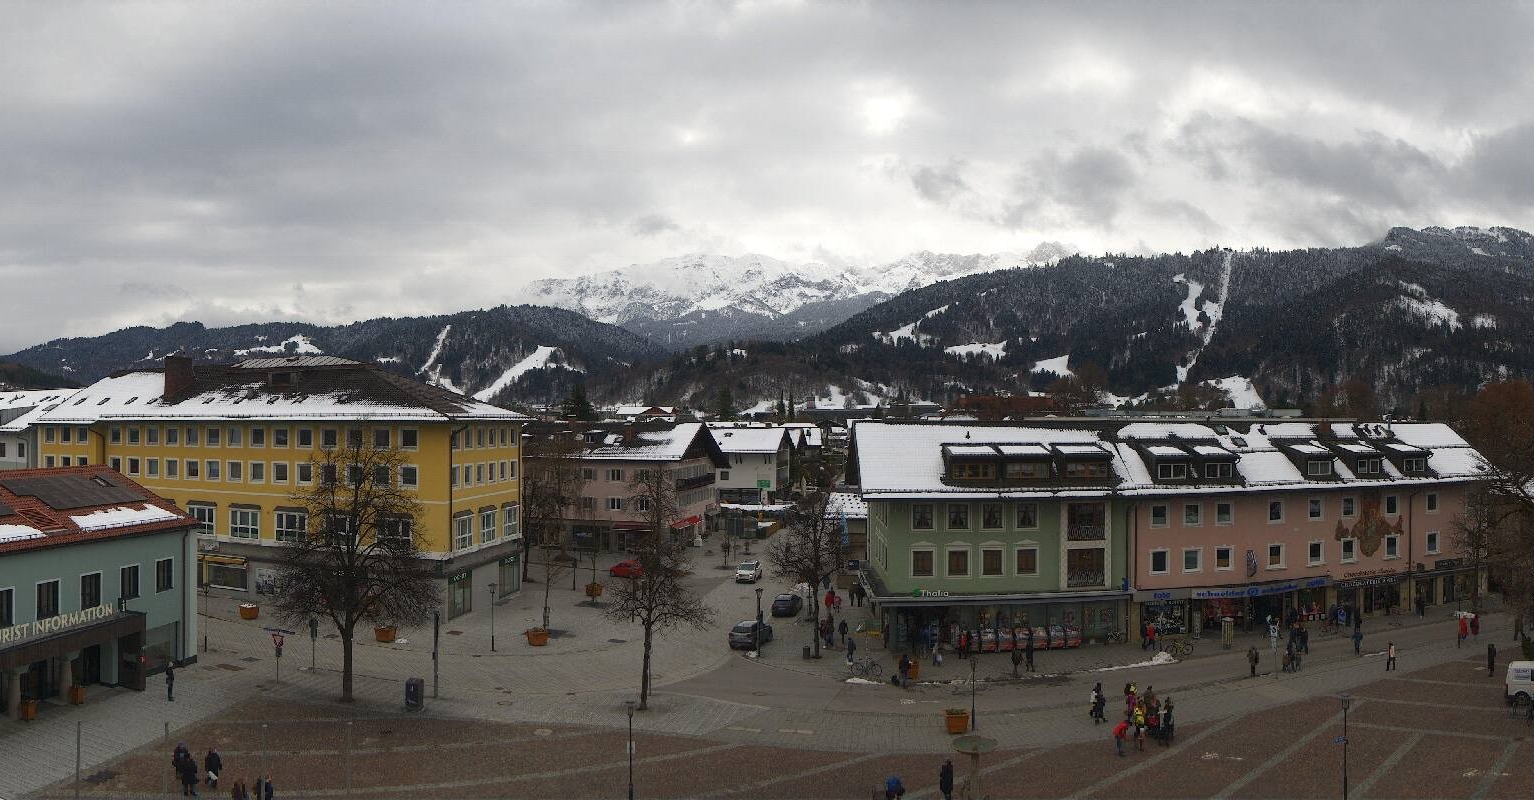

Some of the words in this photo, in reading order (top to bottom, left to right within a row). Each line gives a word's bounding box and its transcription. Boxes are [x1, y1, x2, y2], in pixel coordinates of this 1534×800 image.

[1340, 578, 1381, 588] CHOCOLATERIE
[921, 589, 949, 597] Thalia
[32, 603, 114, 636] INFORMATION
